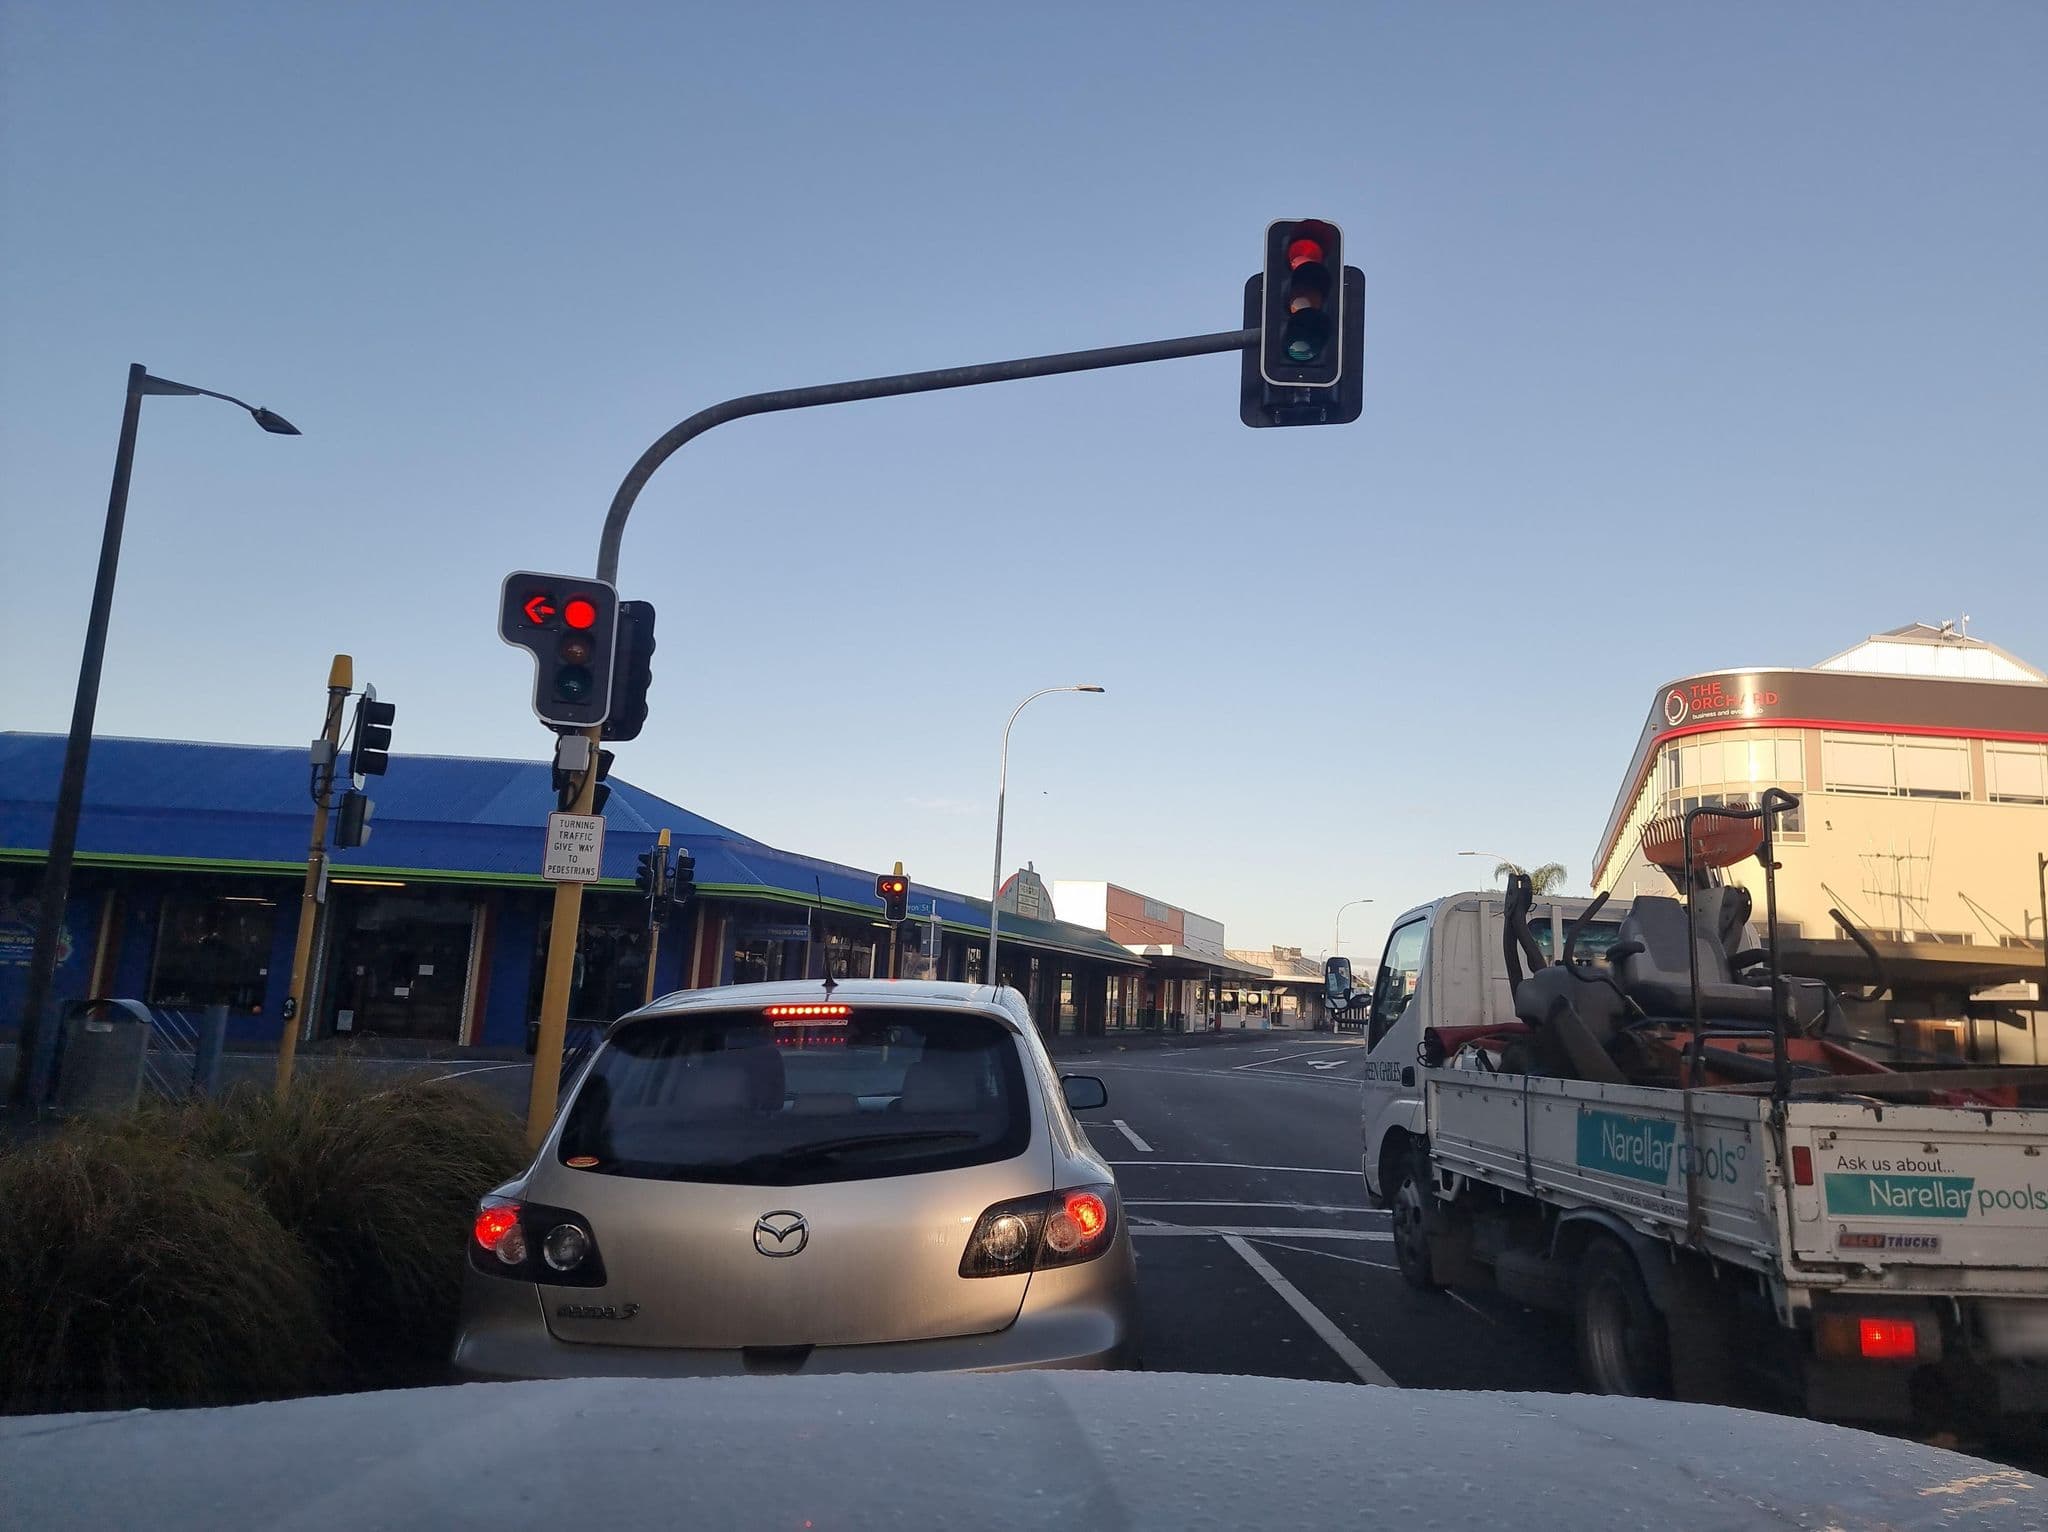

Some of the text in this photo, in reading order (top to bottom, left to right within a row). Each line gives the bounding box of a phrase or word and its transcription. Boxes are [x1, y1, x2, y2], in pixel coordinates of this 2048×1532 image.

[1691, 682, 1721, 697] THE
[1690, 692, 1778, 711] ORCHARD
[560, 819, 595, 829] TURNING
[559, 831, 593, 842] TRAFFIC
[554, 843, 594, 853] GIVE WAY
[569, 855, 578, 863] TO
[547, 865, 596, 876] PEDESTRIANS
[1678, 1137, 1738, 1185] pools
[1837, 1155, 1955, 1173] Ask us about...
[1978, 1183, 2048, 1217] pools
[1887, 1235, 1938, 1248] TRUCKS
